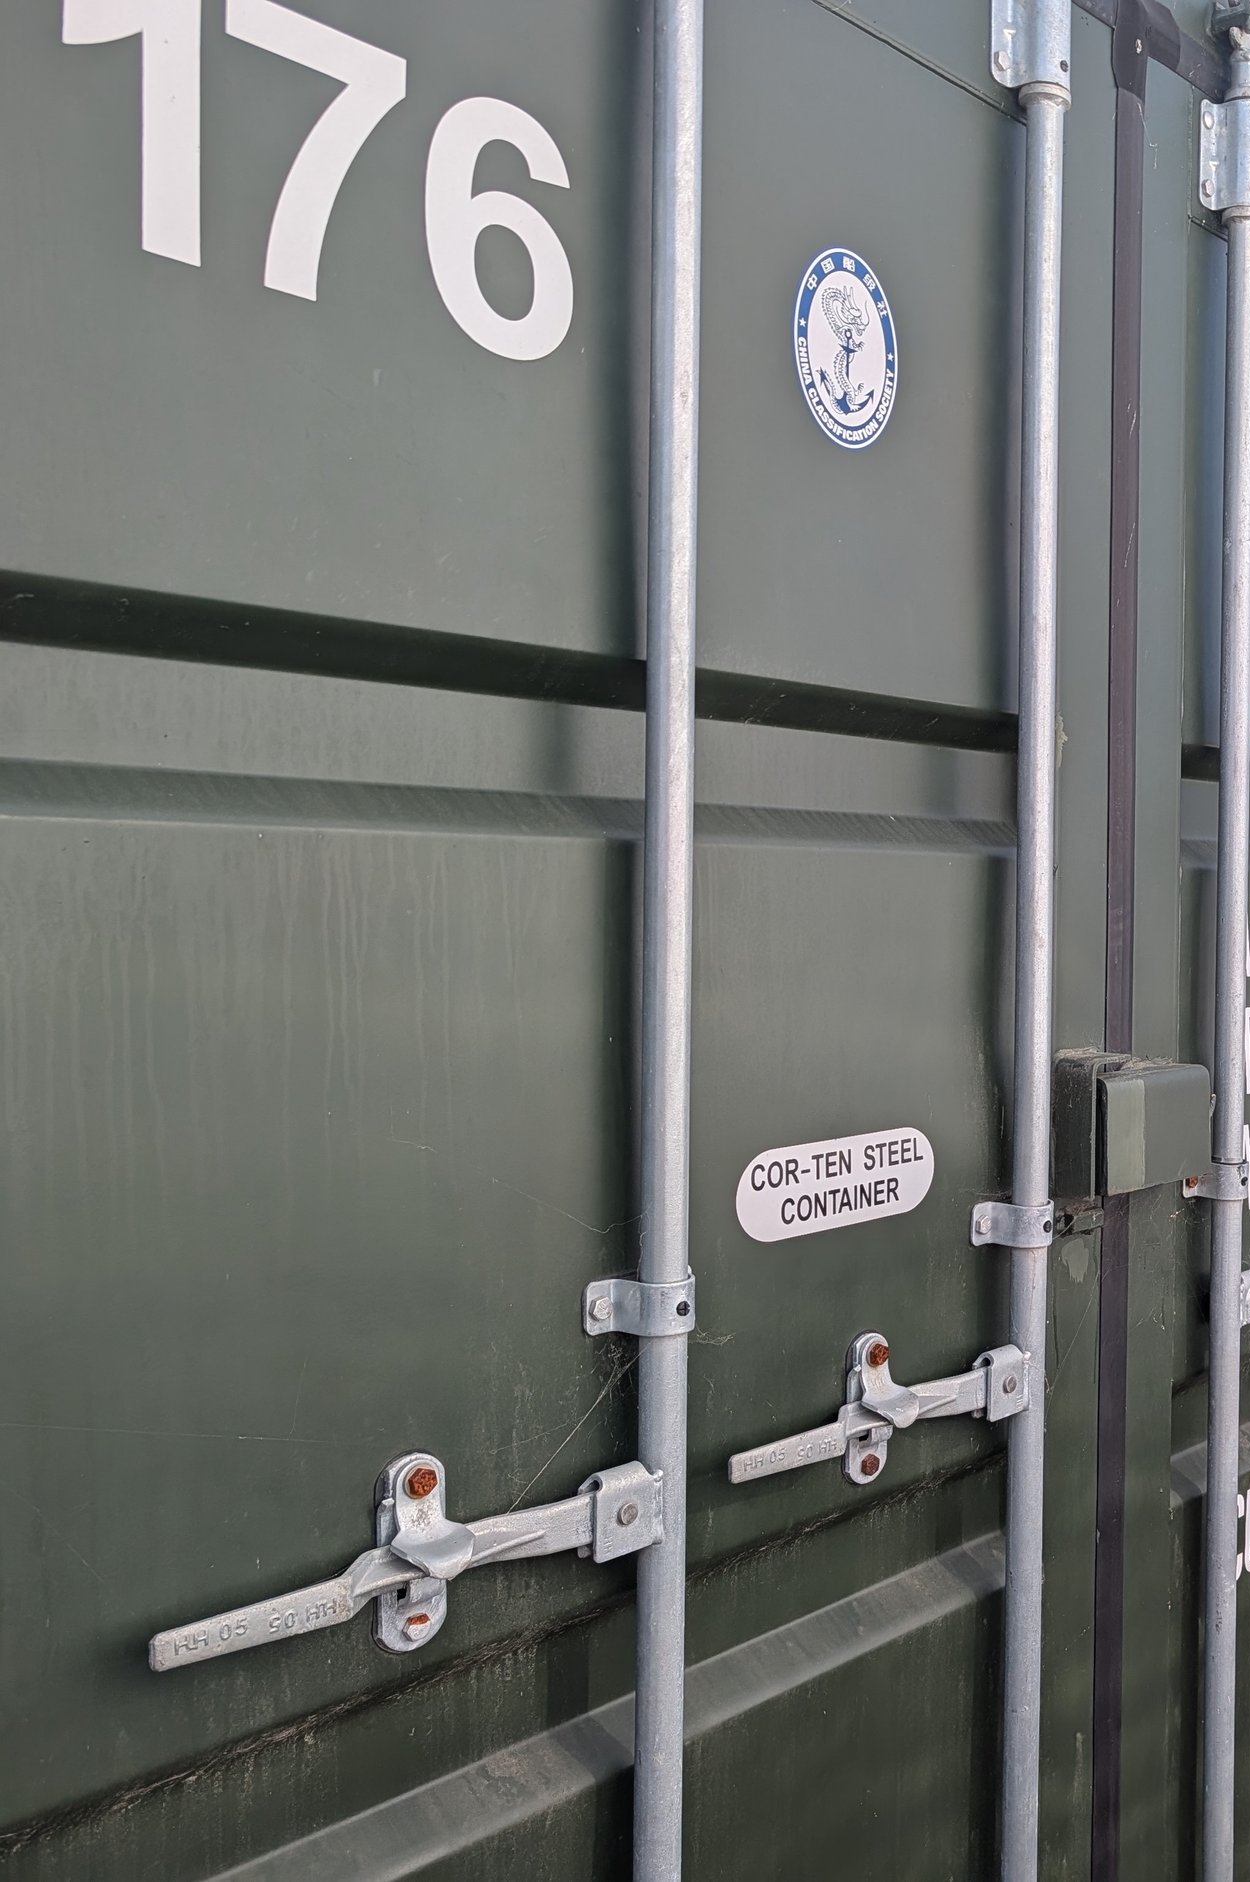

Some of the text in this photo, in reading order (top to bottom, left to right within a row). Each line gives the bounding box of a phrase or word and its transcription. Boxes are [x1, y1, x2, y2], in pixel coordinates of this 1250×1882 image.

[62, 0, 574, 360] 176
[798, 337, 895, 442] CHINA CLASSIFICATION SOCIETY
[751, 1137, 924, 1191] COR-TEN STEEL
[781, 1177, 900, 1225] CONTAINER
